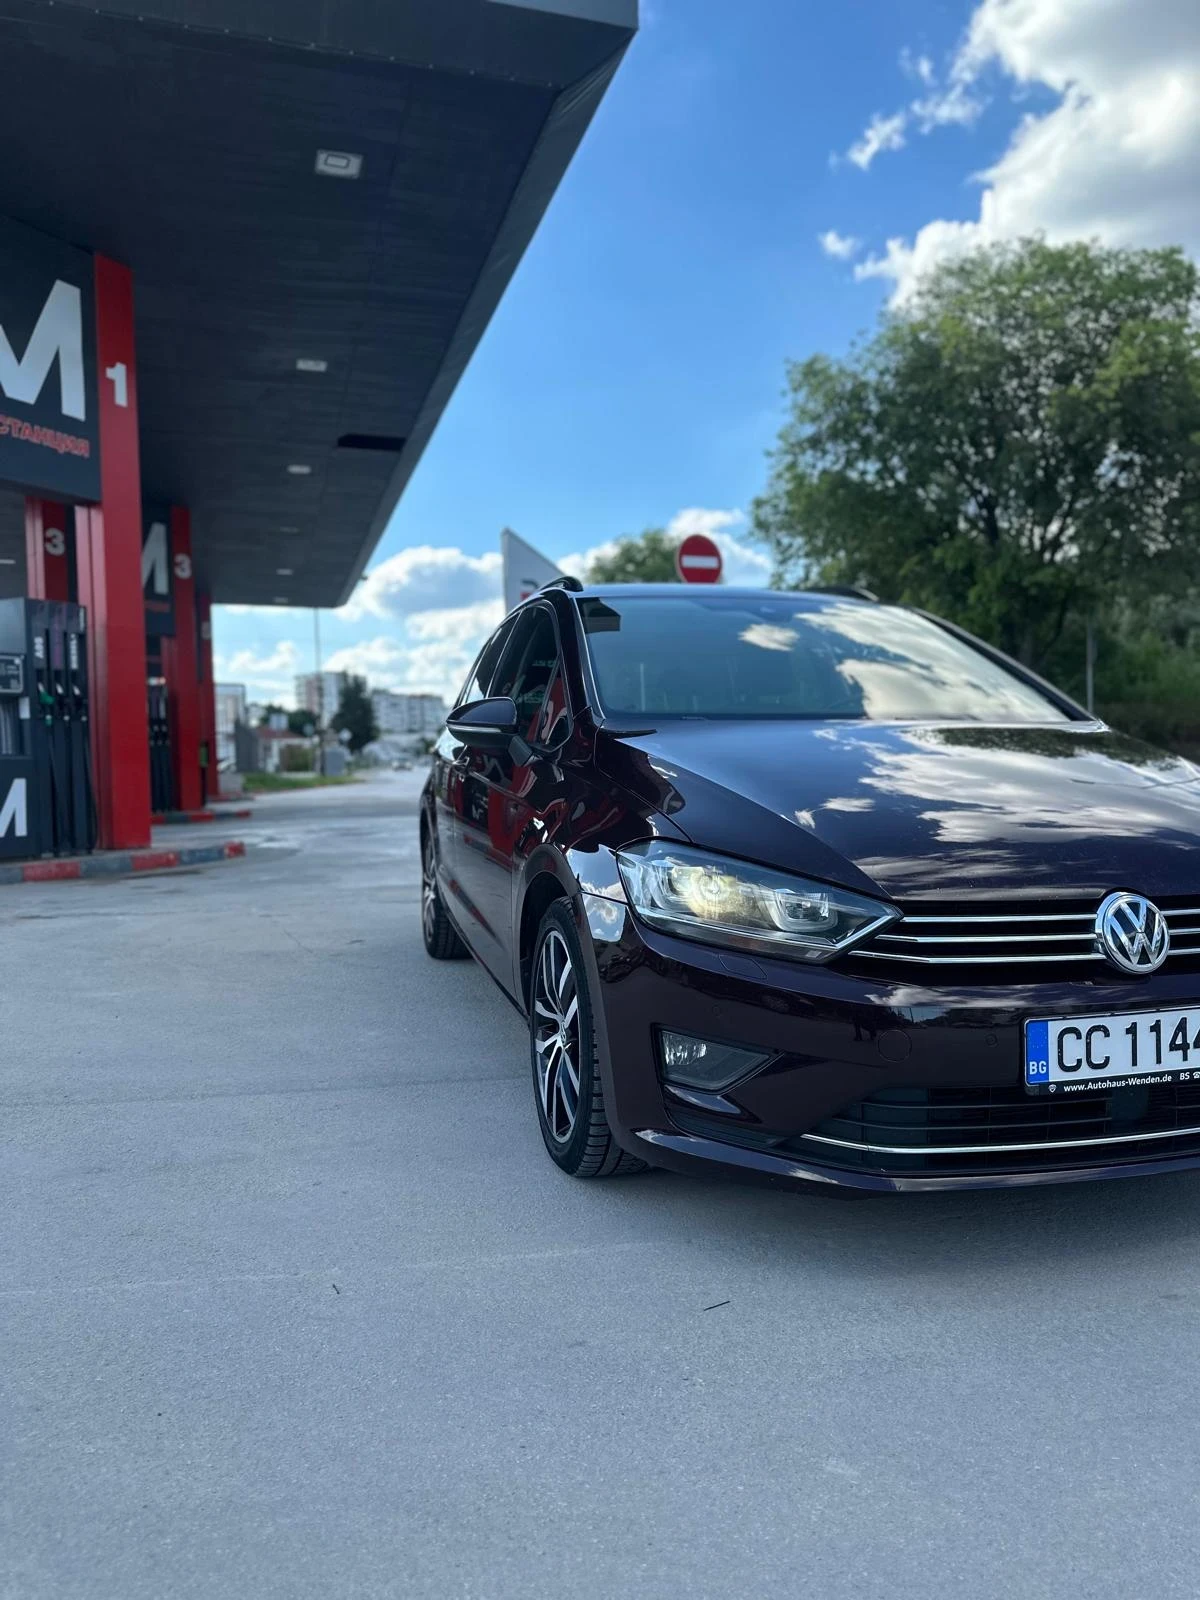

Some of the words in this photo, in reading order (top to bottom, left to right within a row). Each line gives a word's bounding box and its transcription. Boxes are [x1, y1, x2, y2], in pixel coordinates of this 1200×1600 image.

[106, 362, 128, 408] 1
[44, 527, 65, 556] 3
[174, 553, 192, 579] 3
[1029, 1060, 1047, 1075] BG
[1063, 1074, 1172, 1092] www.Autohaus-Wenden.de
